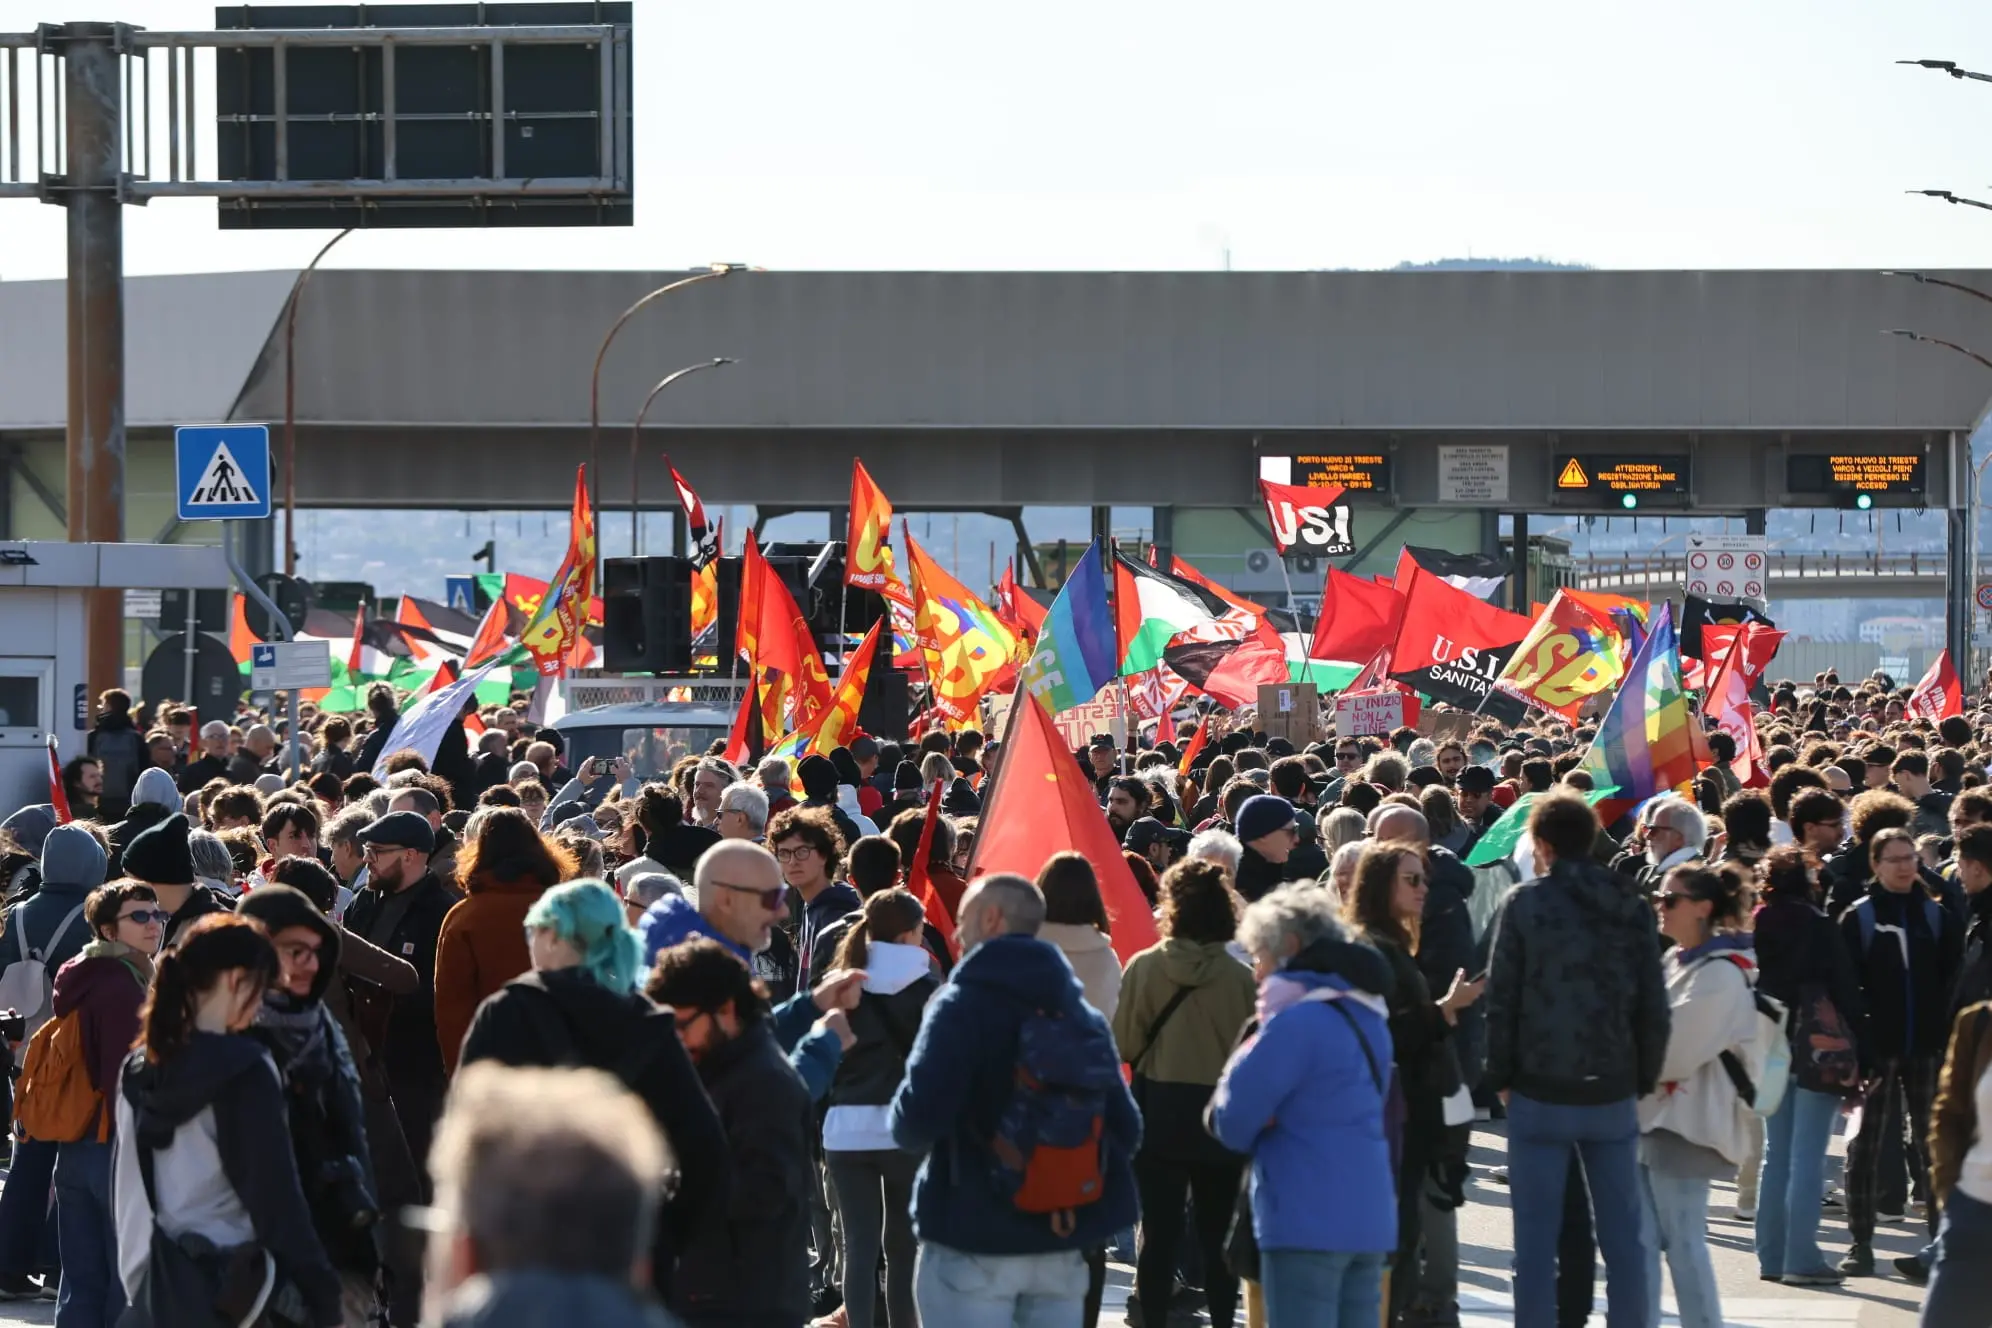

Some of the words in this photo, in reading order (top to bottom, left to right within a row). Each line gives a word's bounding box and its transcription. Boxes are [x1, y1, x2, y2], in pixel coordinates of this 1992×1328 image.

[1297, 456, 1320, 464] PORTO
[1353, 456, 1383, 464] TRIESTE
[1830, 456, 1853, 464] PORTO
[1854, 456, 1877, 464] NUOVO
[1878, 456, 1886, 464] DI
[1888, 456, 1918, 464] TRIESTE
[1832, 465, 1855, 473] VARCO
[1856, 465, 1861, 473] 4
[1863, 465, 1891, 473] VEICOLI
[1598, 473, 1651, 481] REGISTRAZIONE
[1653, 473, 1676, 481] BADGE
[1902, 473, 1910, 481] DI
[1856, 482, 1888, 490] ACCESSO
[1267, 500, 1350, 545] USI
[936, 696, 965, 720] BASE
[1375, 710, 1394, 722] LA
